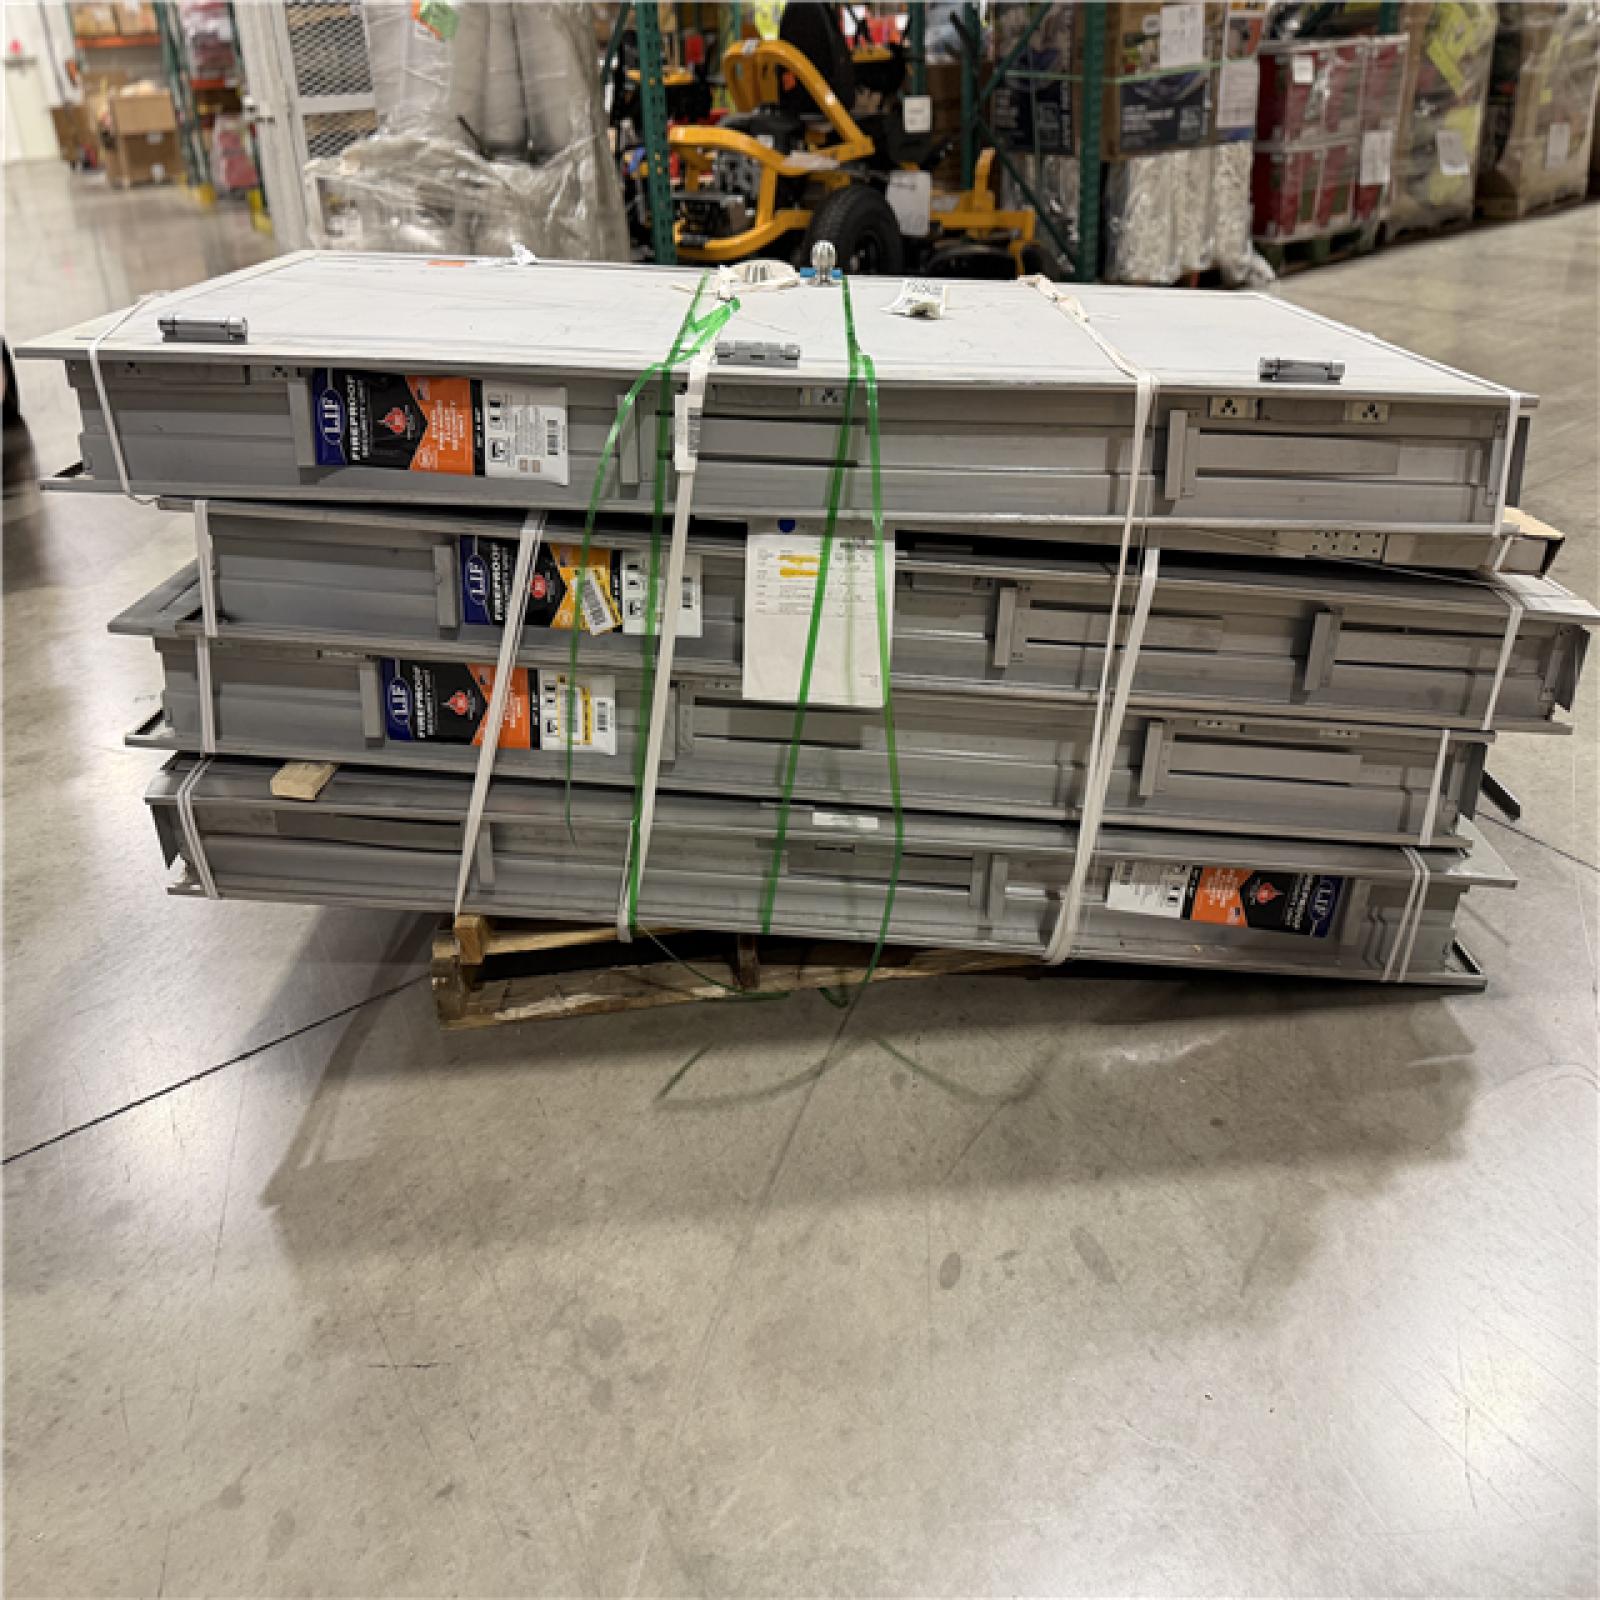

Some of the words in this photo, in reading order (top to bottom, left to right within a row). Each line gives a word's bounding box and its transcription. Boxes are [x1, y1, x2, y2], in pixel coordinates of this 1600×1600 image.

[322, 397, 340, 433] LIF
[469, 562, 486, 595] LIF
[391, 684, 409, 715] LIF
